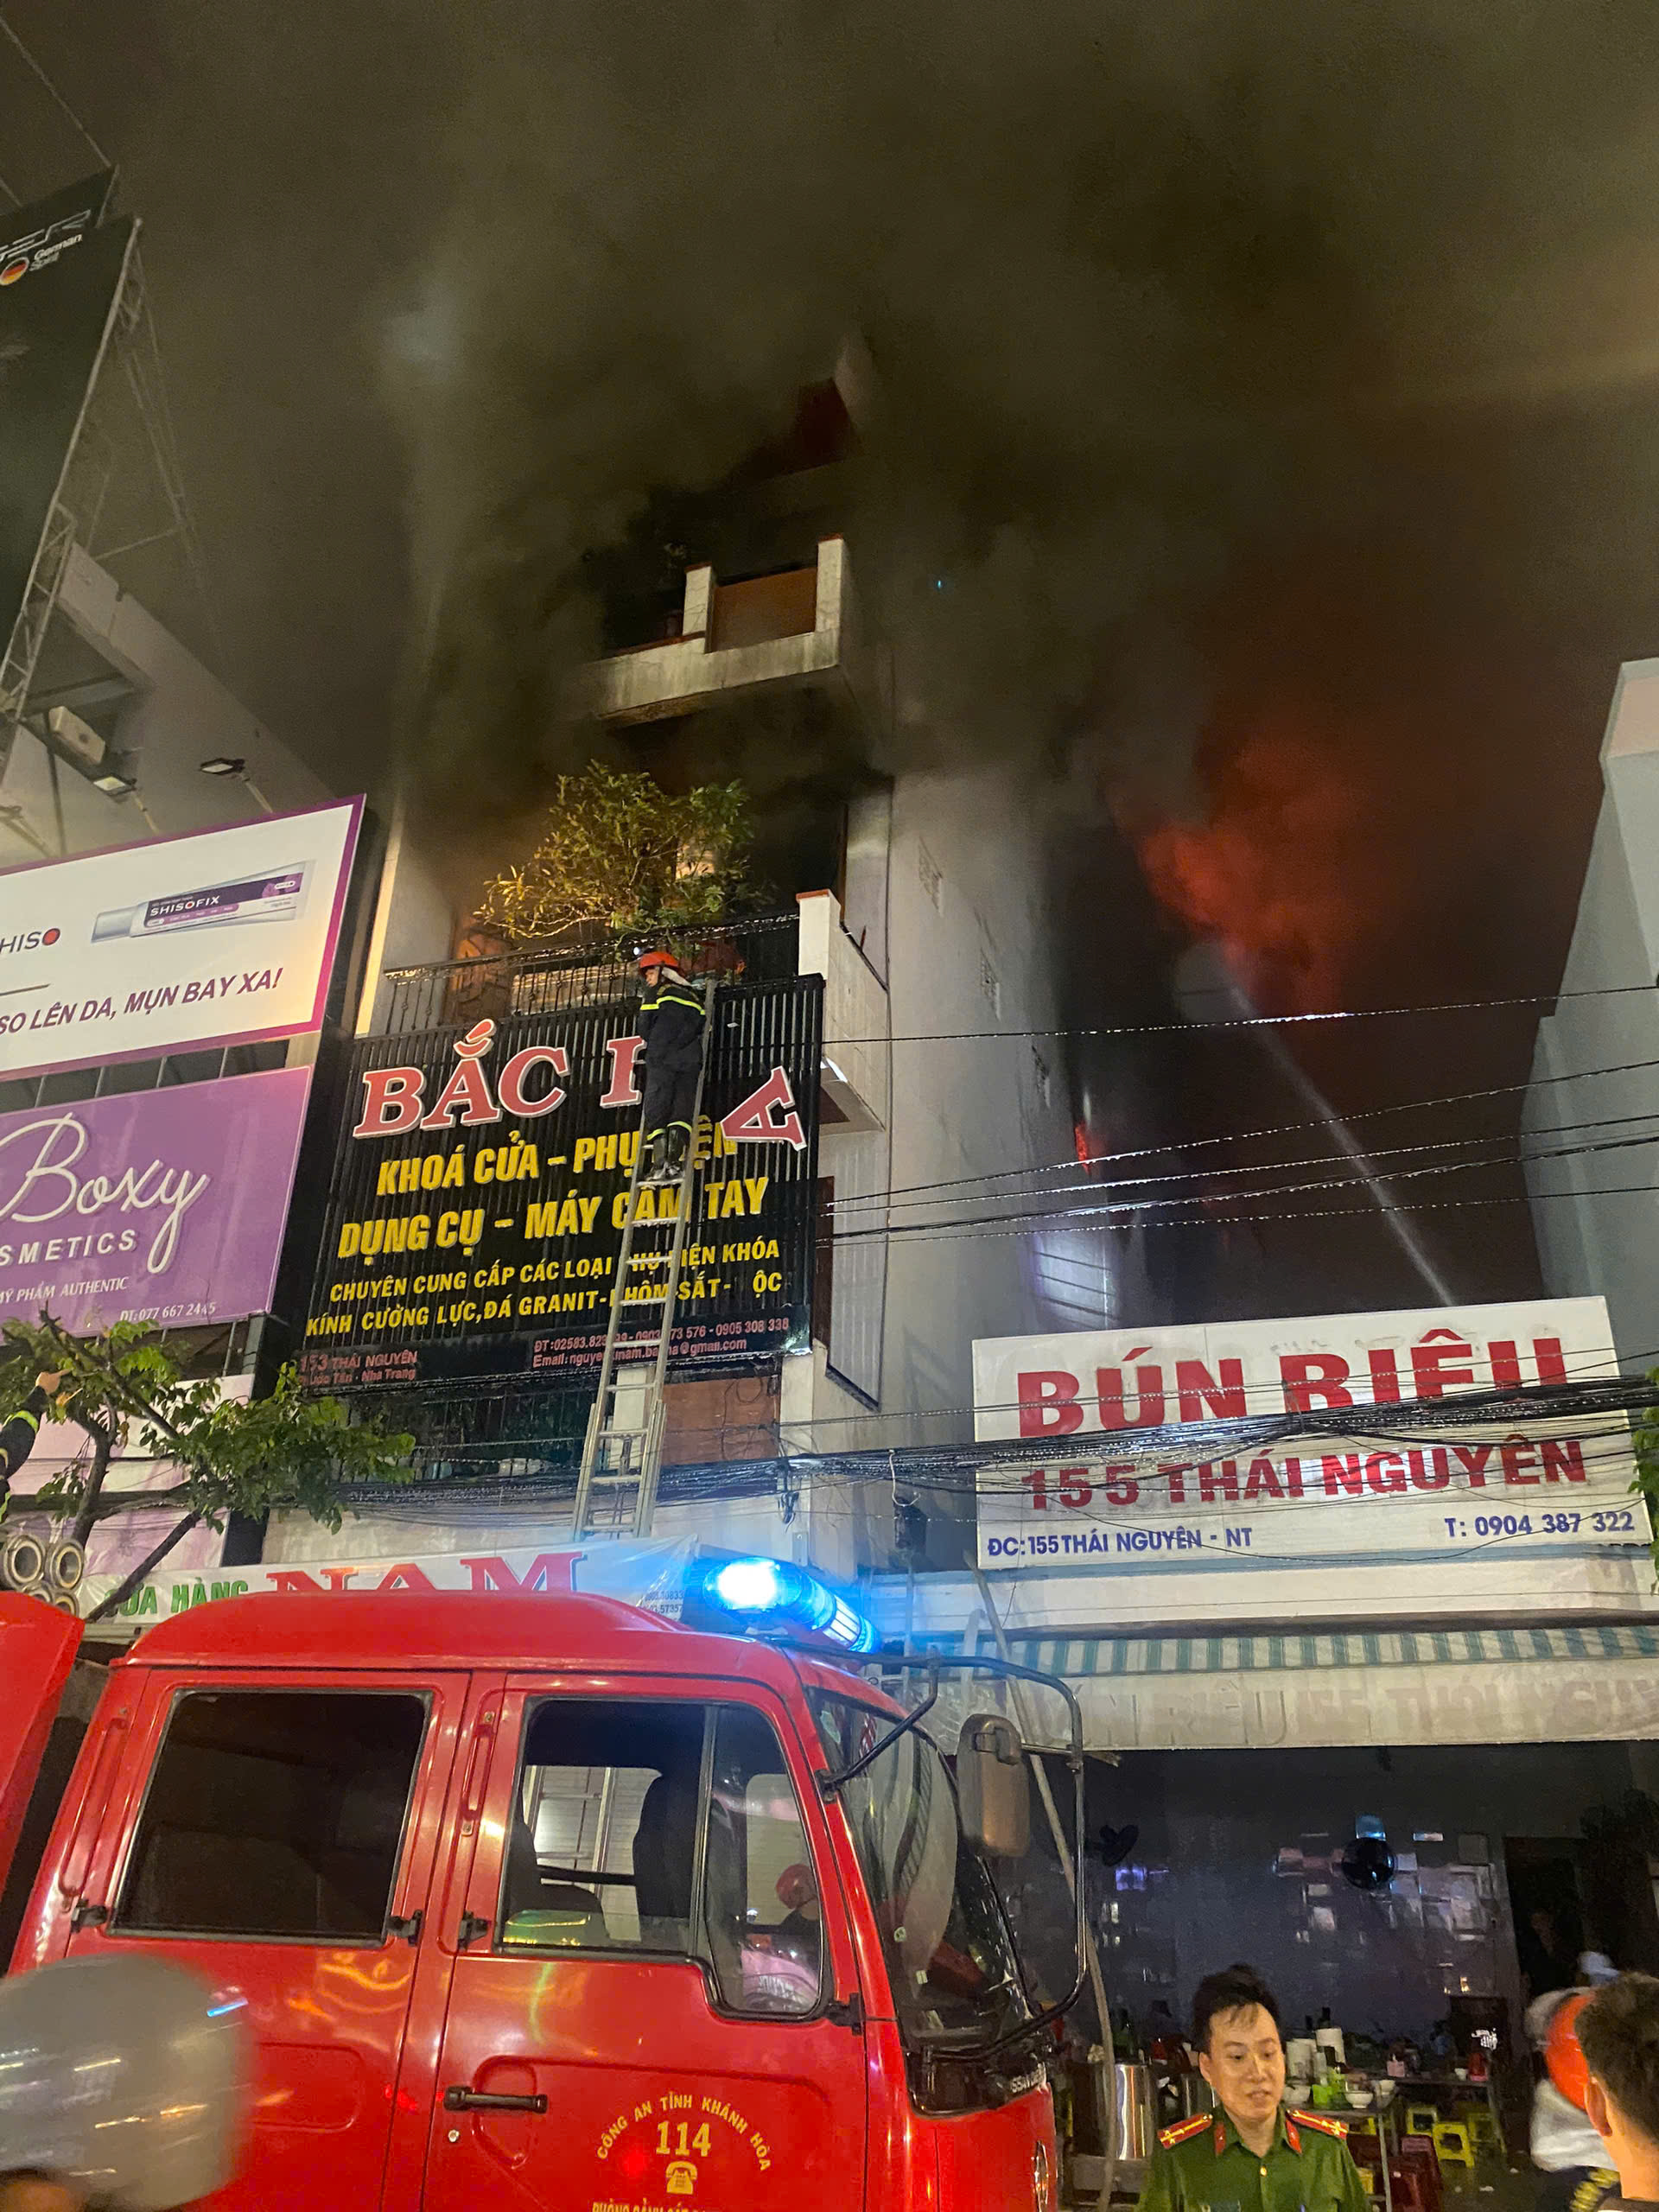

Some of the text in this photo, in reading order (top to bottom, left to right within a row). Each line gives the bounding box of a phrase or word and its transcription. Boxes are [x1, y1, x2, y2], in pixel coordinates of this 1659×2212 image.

[150, 895, 220, 916] SHISOFIX
[29, 1001, 78, 1030] LÊN
[79, 997, 117, 1021] DA,
[124, 983, 179, 1015] MỤN
[181, 974, 238, 1005] BAY
[237, 968, 283, 995] XA!
[353, 1019, 570, 1139] BẮC
[377, 1144, 465, 1196] KHOÁ
[474, 1130, 539, 1184] CỬA
[0, 1112, 211, 1274] Boxy
[338, 1214, 431, 1266] DỤNG
[435, 1209, 486, 1256] CỤ
[524, 1189, 602, 1238] MÁY
[704, 1176, 769, 1220] TAY
[60, 1276, 130, 1297] AUTHENTIC
[330, 1274, 408, 1302] CHUYÊN
[413, 1271, 467, 1294] CUNG
[474, 1259, 515, 1288] CẤP
[520, 1258, 559, 1283] CÁC
[564, 1256, 613, 1280] LOẠI
[668, 1243, 715, 1270] IỆN
[722, 1235, 779, 1263] KHÓA
[162, 1305, 183, 1318] 667
[306, 1313, 353, 1337] KÍNH
[361, 1304, 429, 1331] CƯỜNG
[686, 1325, 706, 1339] 576
[715, 1321, 741, 1336] 0905
[365, 1349, 417, 1367] NGUYÊN
[1018, 1346, 1247, 1438] BÚN
[1021, 1433, 1587, 1510] 155 THÁI NGUYÊN
[1065, 1529, 1109, 1554] THÁI
[1116, 1525, 1203, 1552] NGUYÊN
[1226, 1527, 1253, 1548] NT
[1475, 1514, 1533, 1536] 0904
[1541, 1512, 1580, 1534] 387
[1592, 1510, 1636, 1533] 322
[597, 2090, 772, 2171] CÔNG AN TỈNH KHÁNH HÒA
[656, 2120, 712, 2158] 114
